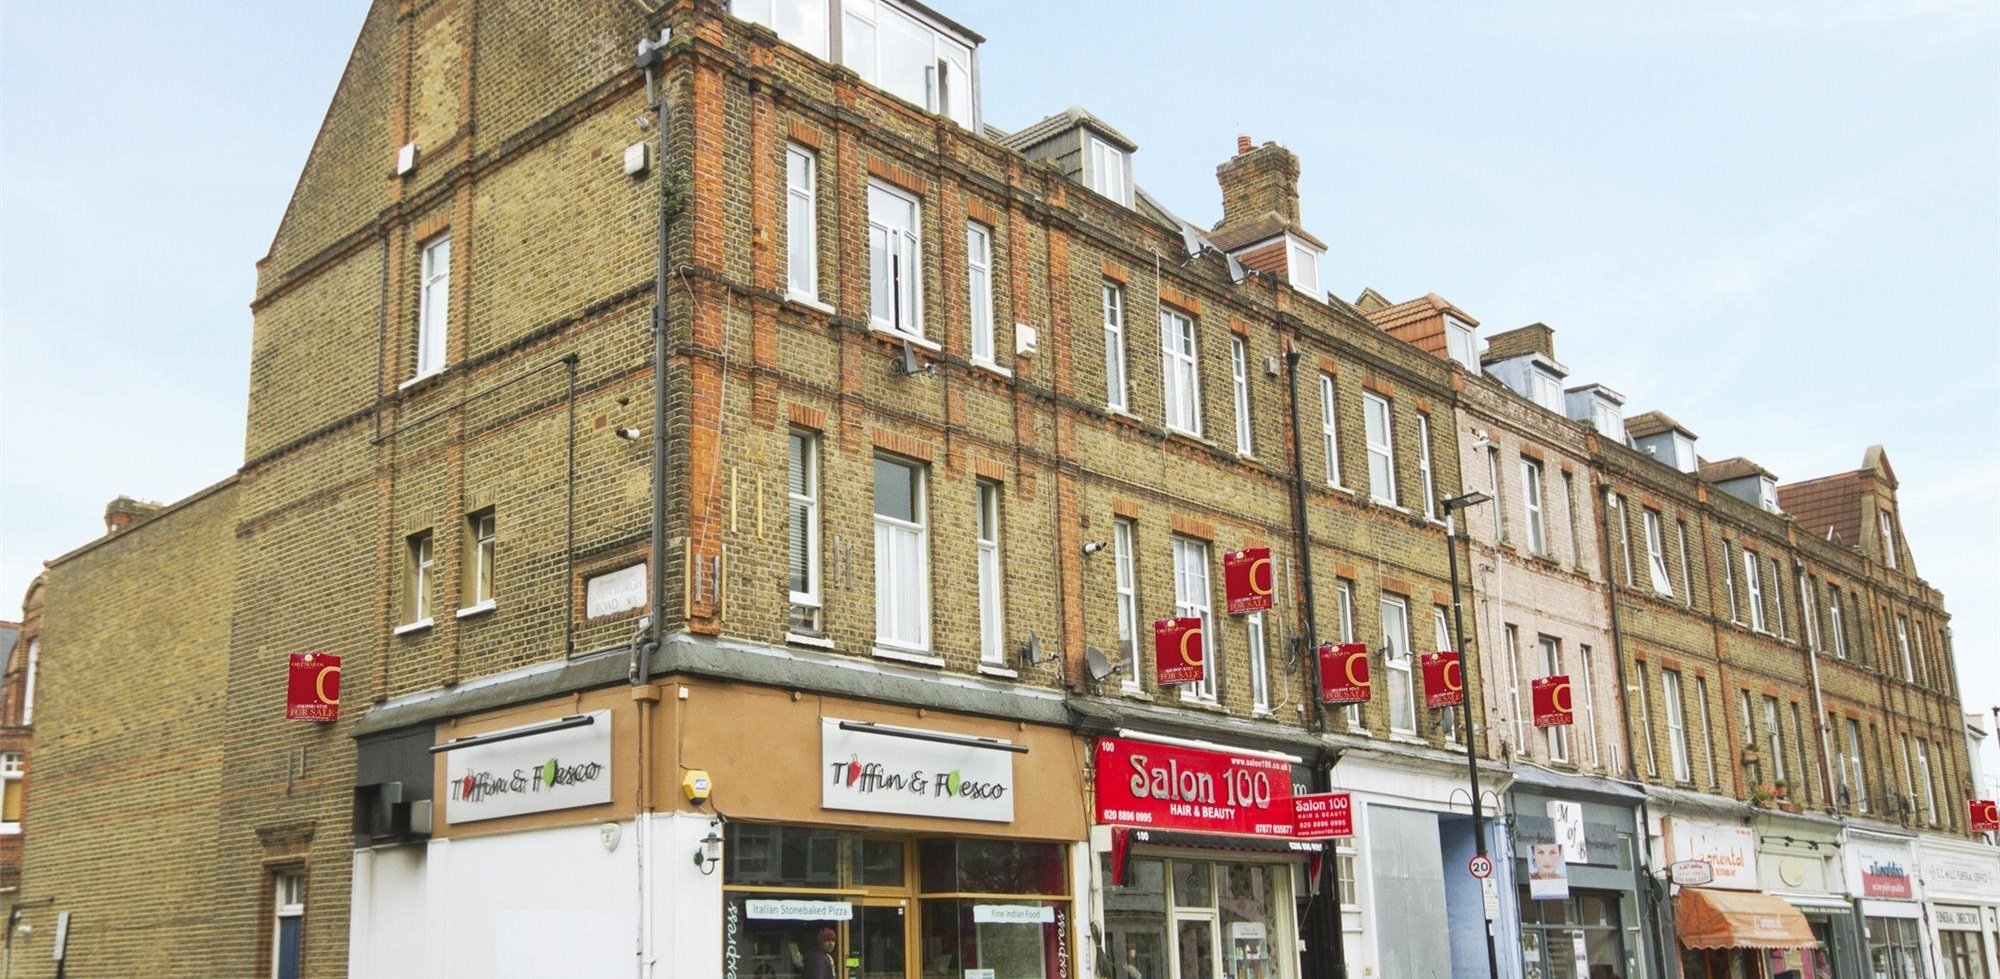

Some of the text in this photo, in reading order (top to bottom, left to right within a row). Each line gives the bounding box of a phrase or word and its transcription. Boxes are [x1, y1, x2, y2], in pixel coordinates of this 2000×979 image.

[1102, 741, 1115, 753] 100
[511, 769, 527, 794] &
[532, 758, 605, 792] Fesco
[910, 770, 928, 794] &
[935, 769, 1008, 799] Fesco
[1129, 753, 1272, 810] Salon 100
[1170, 803, 1236, 820] HAIR & BEAUTY
[1295, 797, 1348, 812] Salon 100
[1557, 803, 1569, 823] M
[1136, 831, 1149, 841] 100
[1567, 819, 1578, 848] of
[1472, 862, 1489, 873] 20
[753, 904, 848, 916] Italian Stonebaked Pizza
[1057, 909, 1069, 978] express
